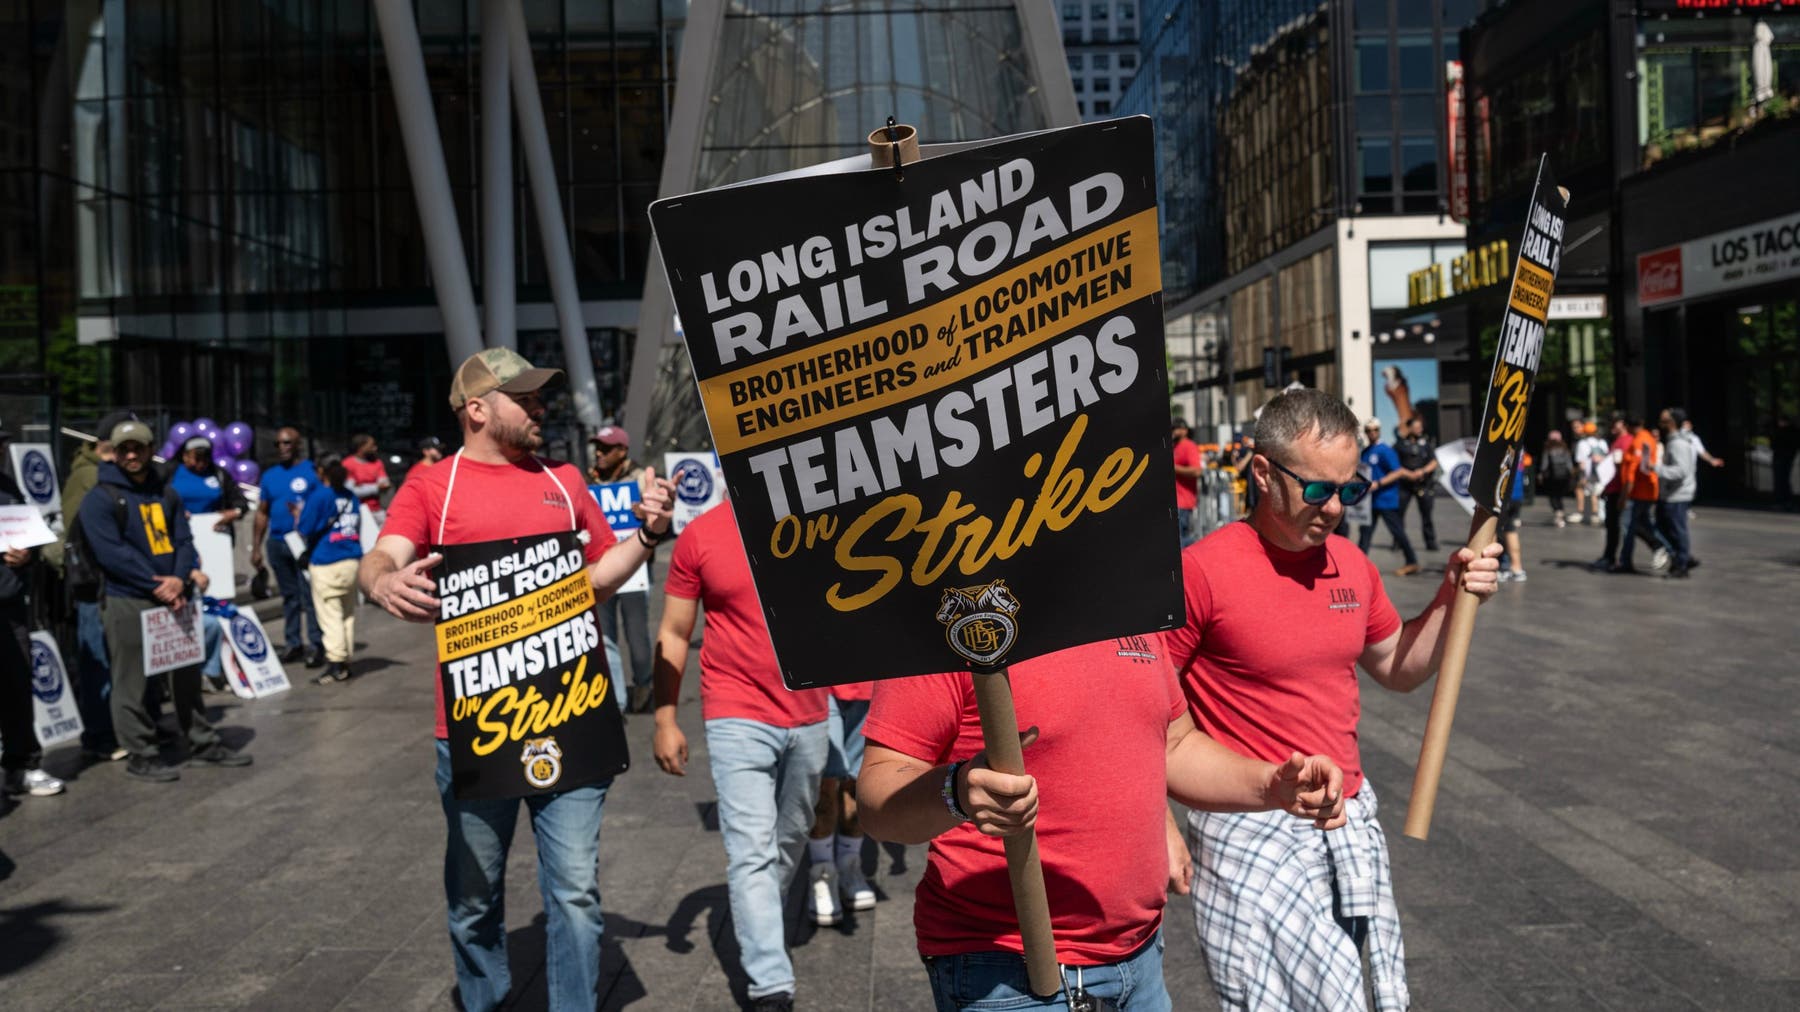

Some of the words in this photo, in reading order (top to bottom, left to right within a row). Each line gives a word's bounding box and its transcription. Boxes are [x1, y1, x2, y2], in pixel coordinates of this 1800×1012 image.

[700, 235, 836, 314] LONG
[844, 158, 1035, 268] ISLAND
[1523, 227, 1551, 268] RAIL
[1531, 201, 1551, 234] LONG
[1550, 215, 1564, 242] ISL
[1712, 236, 1748, 267] LOS
[712, 276, 888, 365] RAIL
[903, 171, 1125, 304] ROAD
[1513, 284, 1545, 310] ENGINEERS
[730, 323, 928, 406] BROTHERHOOD
[937, 313, 958, 347] of
[960, 230, 1132, 326] LOCOMOTIVE
[736, 360, 917, 438] ENGINEERS
[923, 350, 961, 380] and
[963, 264, 1133, 361] TRAINMEN
[749, 315, 1139, 522] TEAMSTERS
[1488, 369, 1528, 443] Str
[770, 513, 838, 559] On
[825, 413, 1150, 612] Strike
[439, 564, 489, 596] LONG
[492, 537, 560, 579] ISLAND
[440, 583, 509, 620] RAIL
[515, 549, 583, 596] ROAD
[1329, 588, 1358, 603] LIRR
[445, 604, 524, 640] BROTHERHOOD
[536, 576, 588, 609] LOCOMOTIVE
[446, 622, 519, 654] ENGINEERS
[521, 615, 538, 631] and
[538, 591, 590, 620] TRAINMEN
[448, 610, 600, 700] TEAMSTERS
[1116, 636, 1152, 652] LIRR
[453, 695, 482, 721] On
[472, 655, 609, 756] Strike
